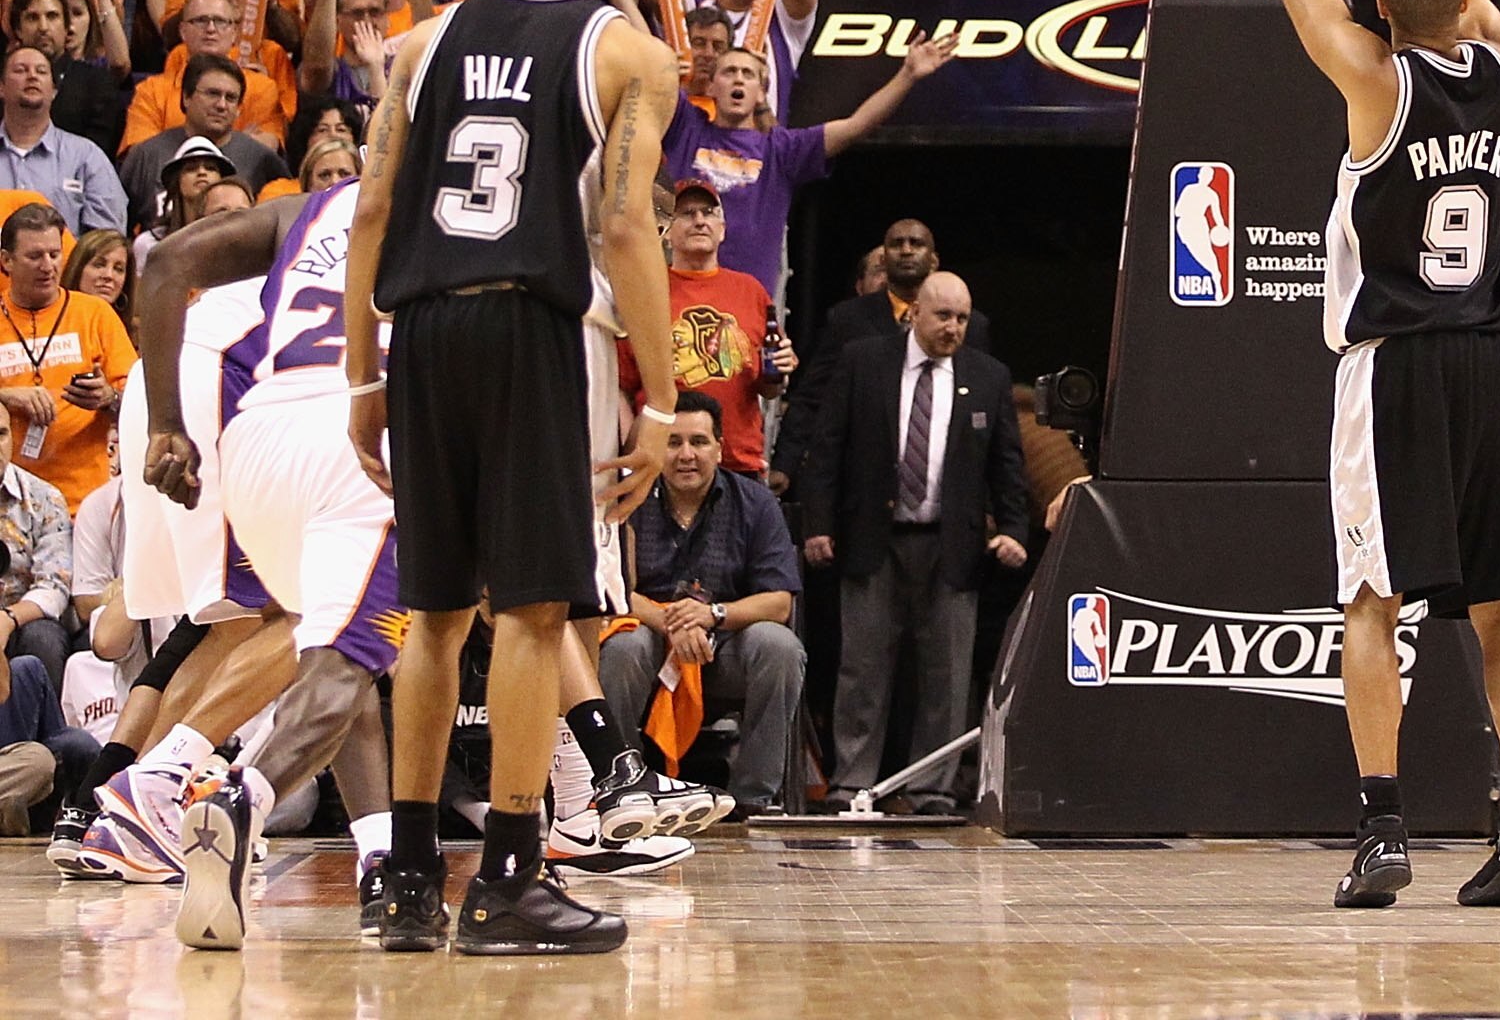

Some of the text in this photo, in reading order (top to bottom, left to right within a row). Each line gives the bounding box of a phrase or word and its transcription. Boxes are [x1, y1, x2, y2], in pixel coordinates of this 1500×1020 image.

[812, 13, 1023, 57] BUD
[464, 54, 534, 102] HILL
[433, 115, 530, 241] 3
[291, 229, 349, 278] RIC
[1245, 226, 1321, 246] Where
[1419, 184, 1489, 291] 9
[1245, 253, 1328, 271] amazin
[1178, 275, 1214, 296] NBA
[1245, 278, 1326, 301] happen
[1073, 619, 1419, 679] NBA PLAYOFS
[83, 697, 118, 725] PHO
[456, 704, 489, 727] NB
